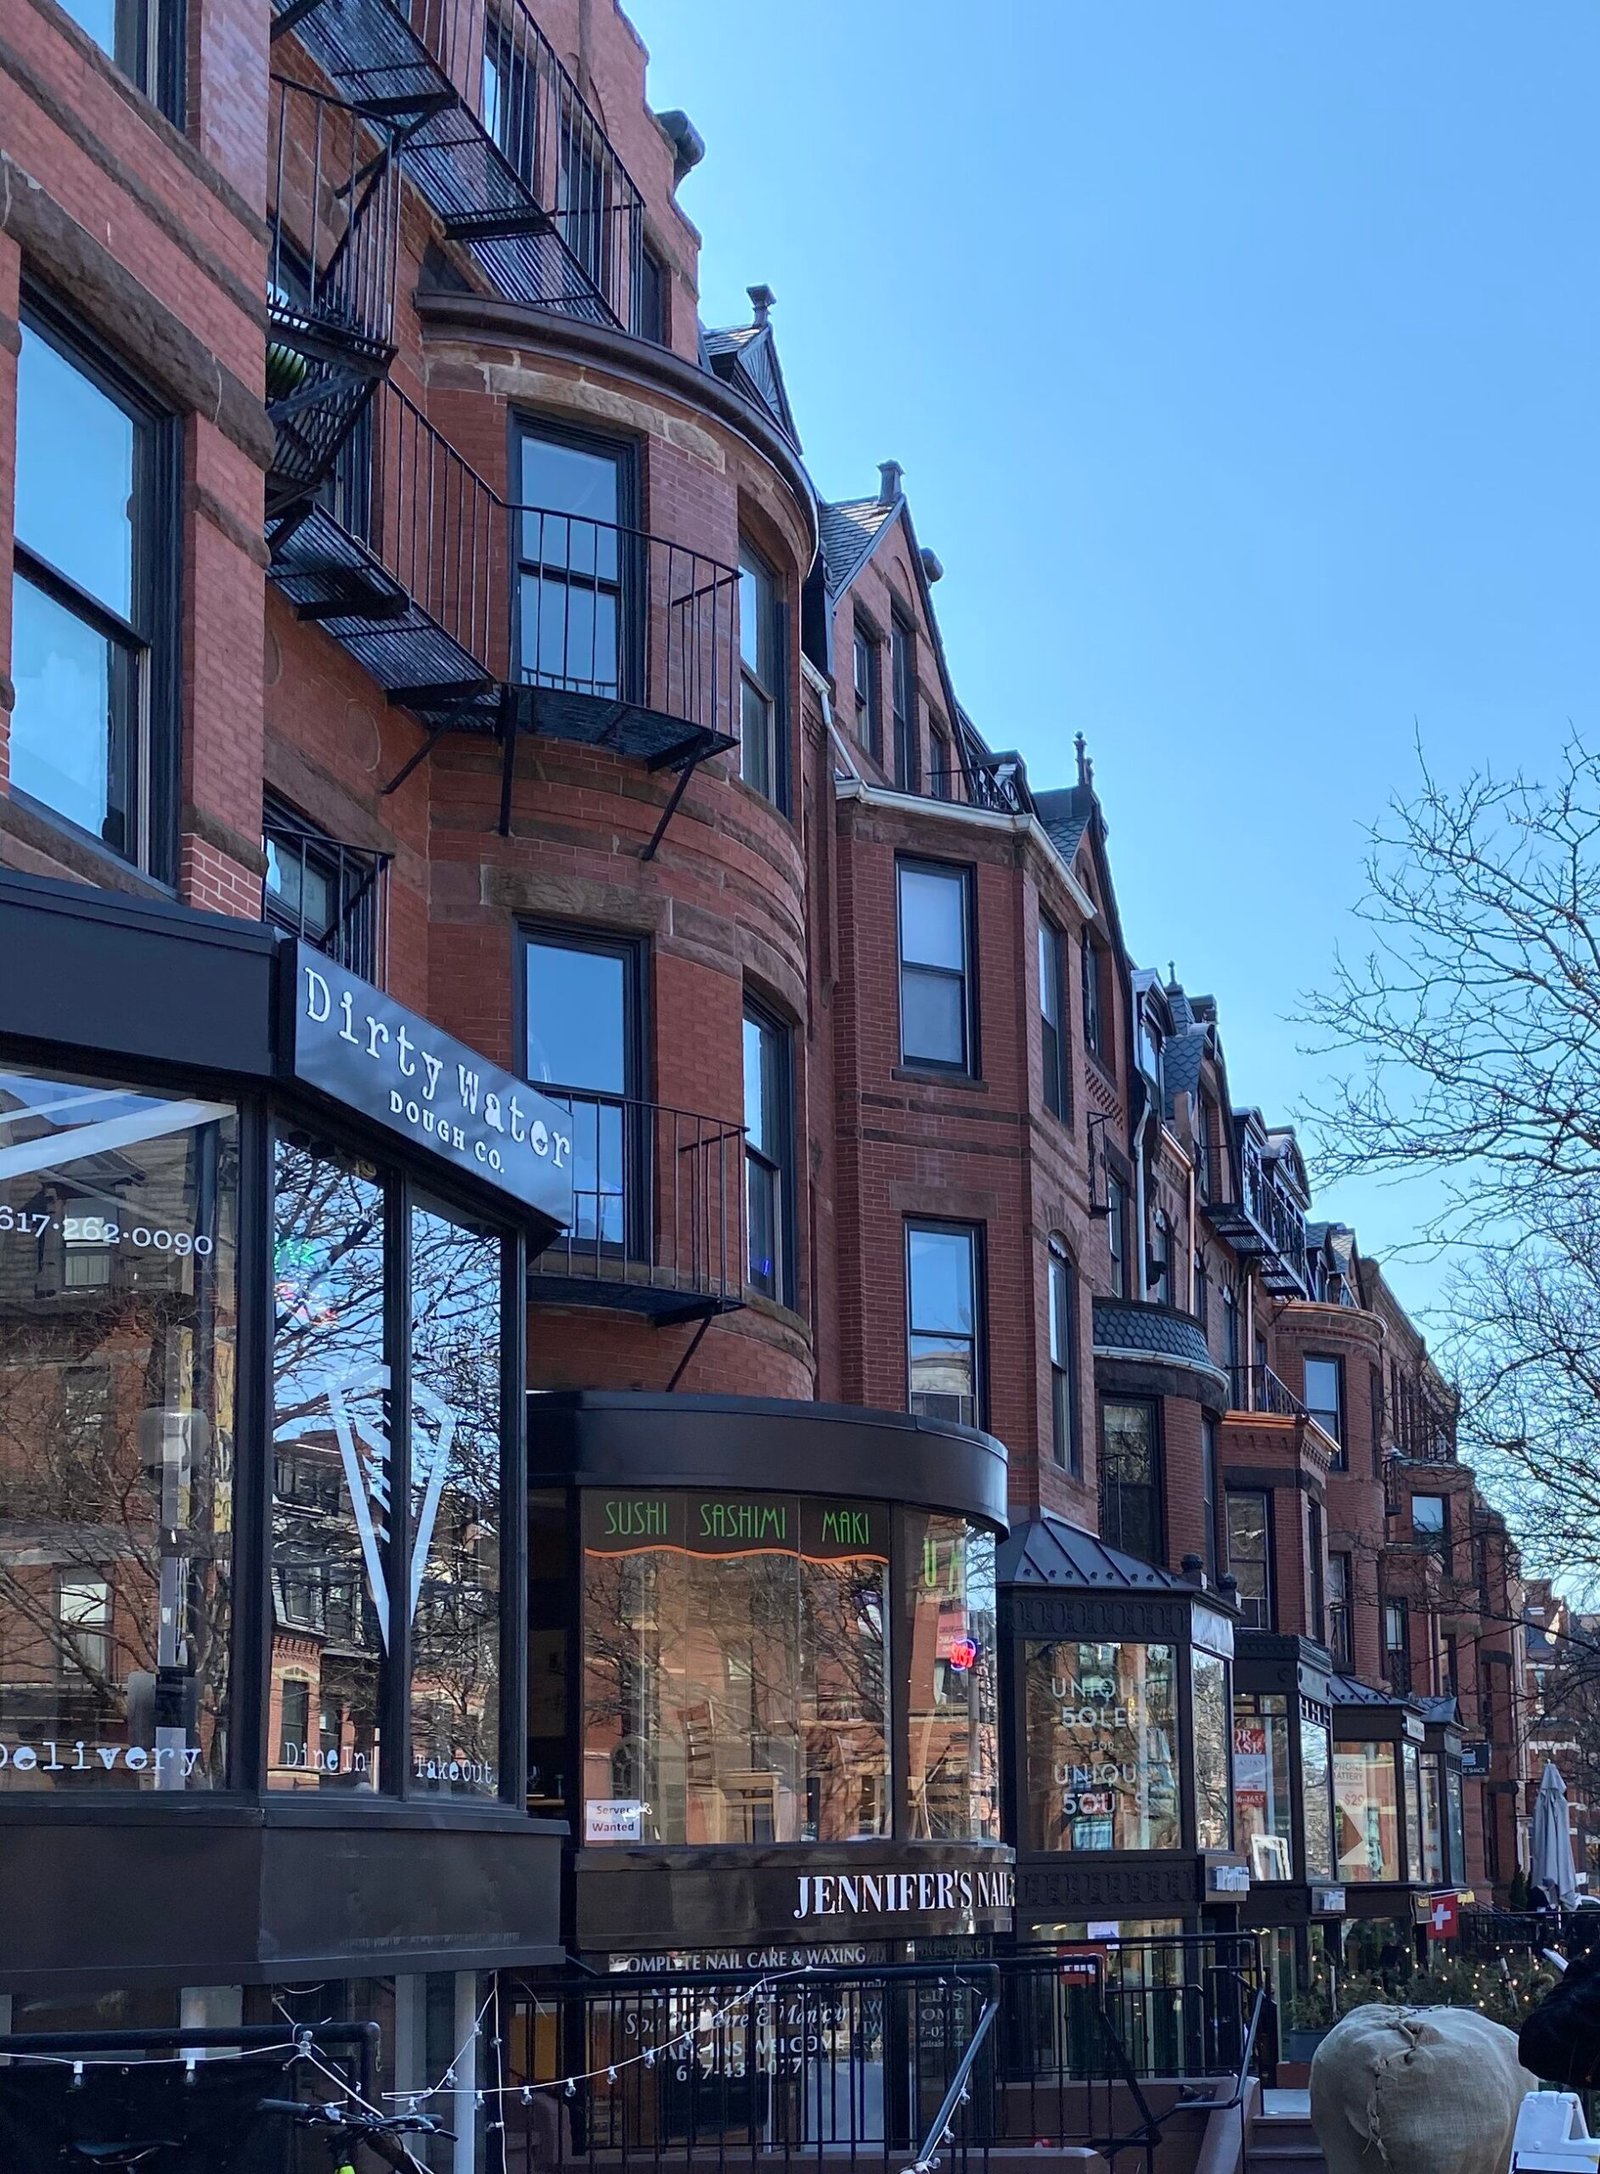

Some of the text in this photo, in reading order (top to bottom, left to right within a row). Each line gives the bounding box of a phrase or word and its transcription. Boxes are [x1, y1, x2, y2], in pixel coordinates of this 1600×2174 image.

[304, 966, 571, 1168] Dirty Water
[389, 1090, 505, 1174] DOUGH CO.
[604, 1501, 870, 1545] SUSHI SASHIMI MAKI
[1051, 1678, 1150, 1701] UNIQU
[284, 1742, 367, 1772] Dine In
[1091, 1741, 1114, 1751] FOR
[414, 1754, 493, 1784] Take Out
[592, 1823, 634, 1831] Wanted
[793, 1869, 973, 1919] JENNIFER'S
[705, 1953, 743, 1970] NAIL
[747, 1951, 787, 1968] CARE
[791, 1950, 802, 1966] &
[806, 1947, 866, 1965] WAXING
